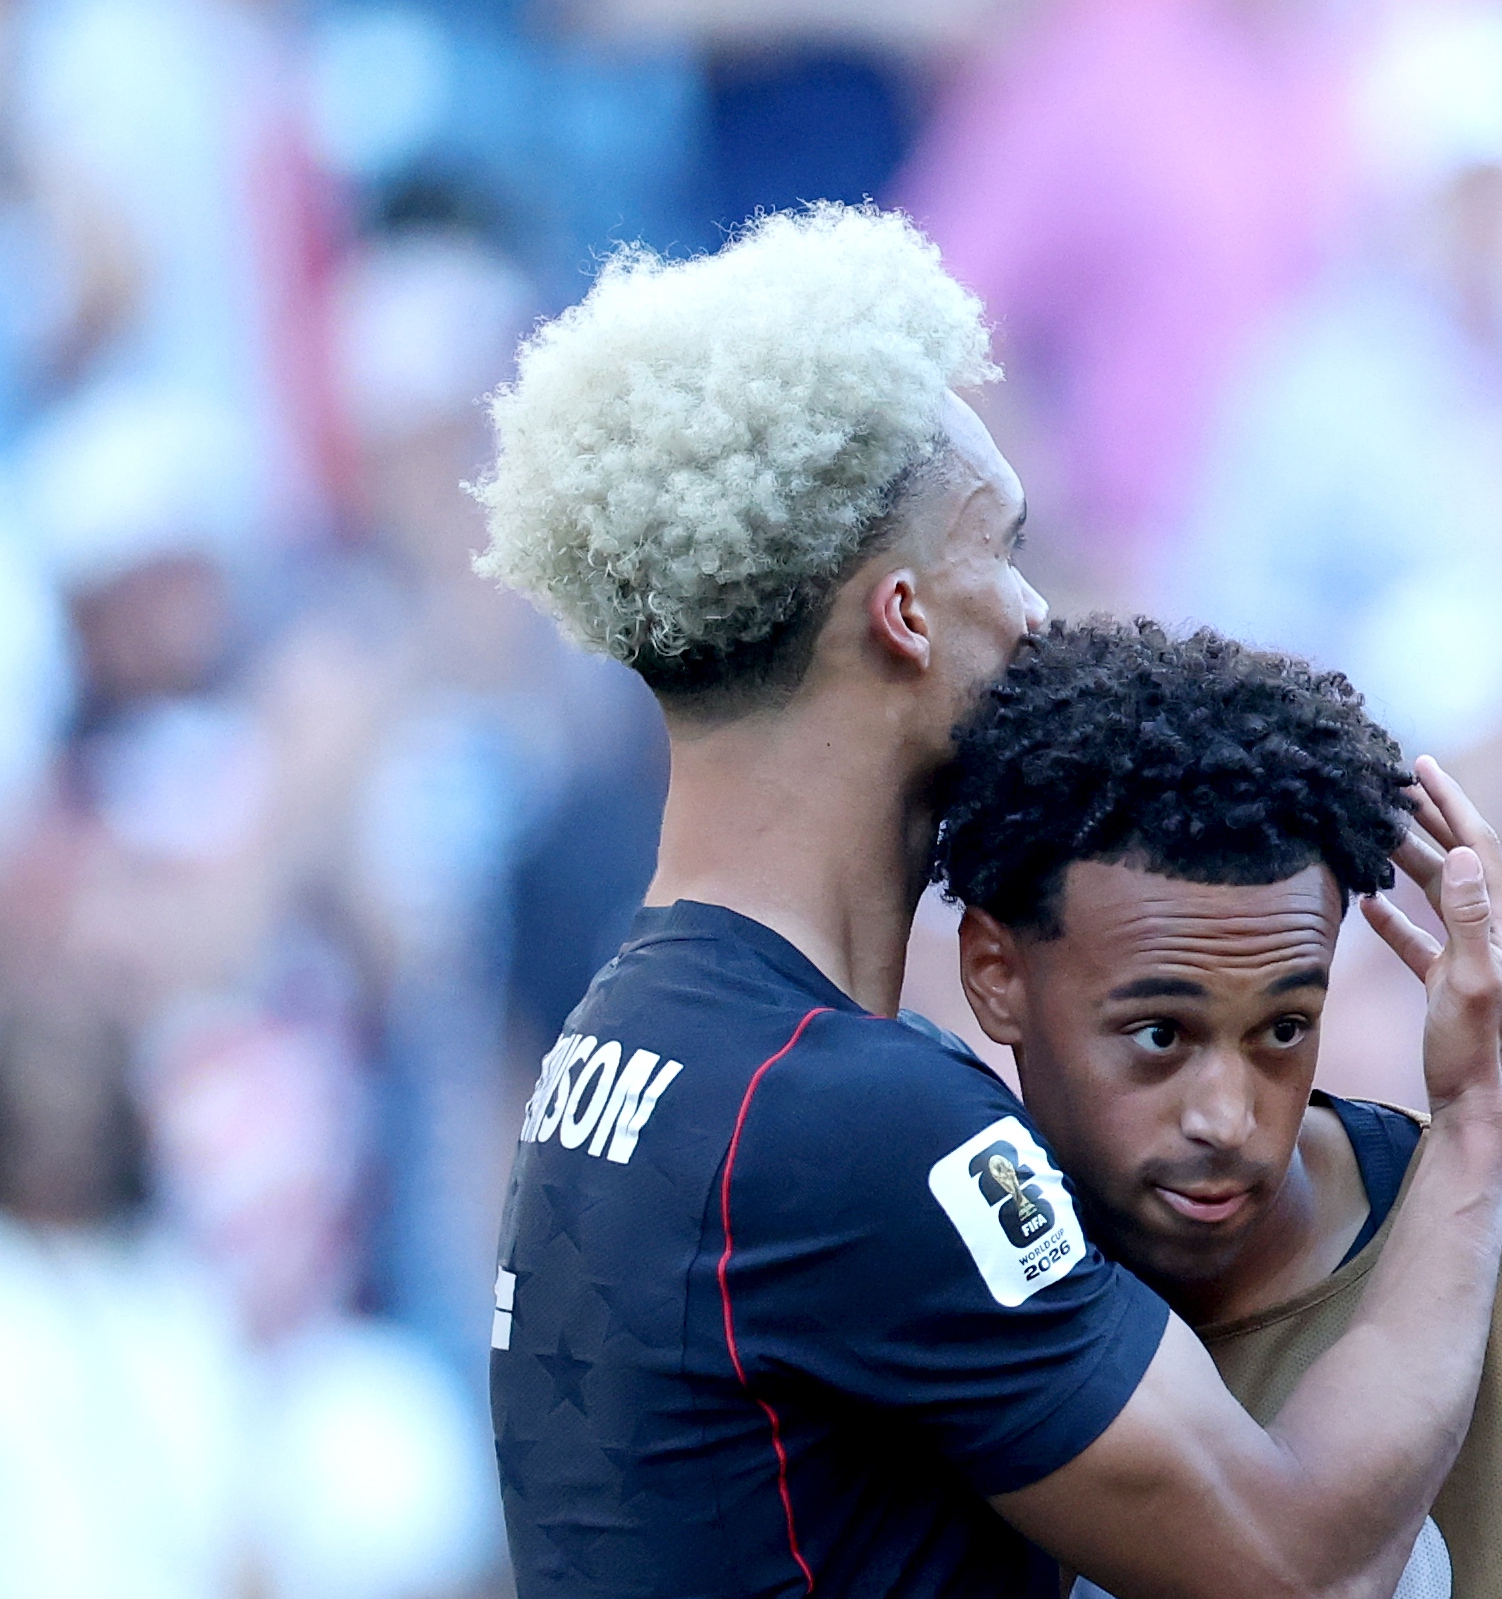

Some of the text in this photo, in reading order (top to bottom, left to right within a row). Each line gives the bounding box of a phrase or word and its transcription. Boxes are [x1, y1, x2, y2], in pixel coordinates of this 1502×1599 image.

[1020, 1214, 1048, 1237] FIFA
[1018, 1227, 1065, 1267] WORLD CUP
[1023, 1239, 1071, 1281] 2026
